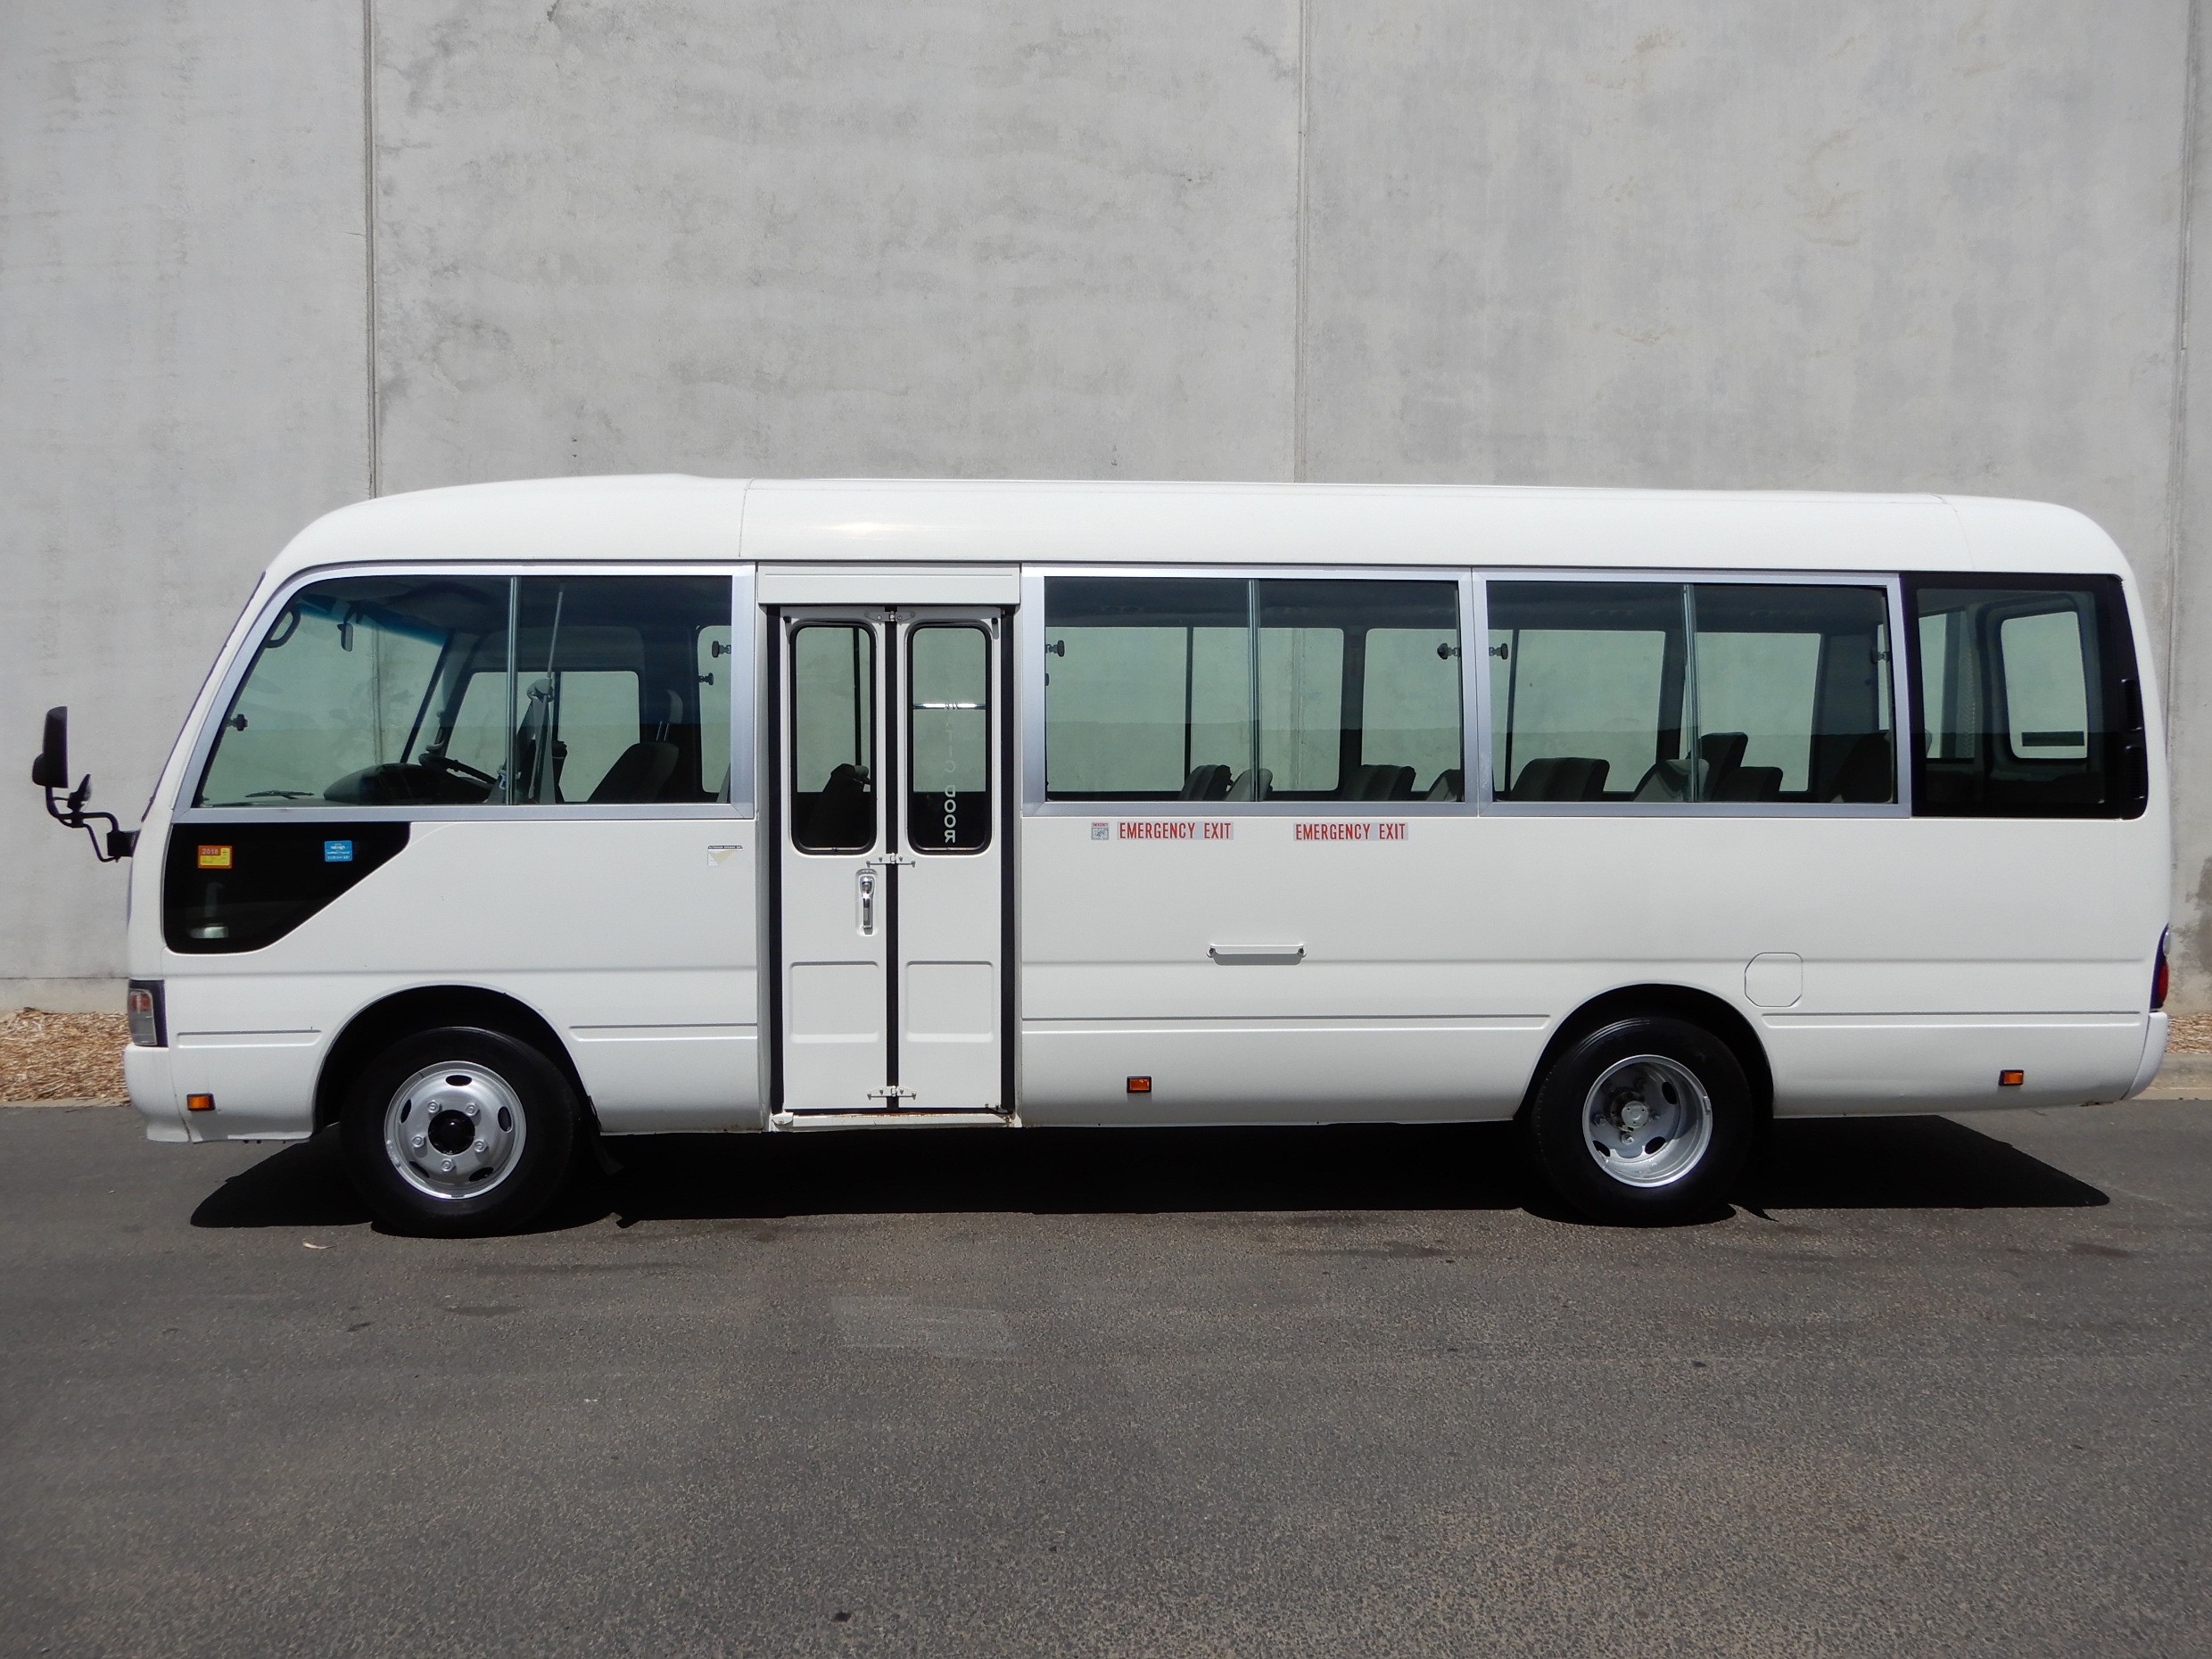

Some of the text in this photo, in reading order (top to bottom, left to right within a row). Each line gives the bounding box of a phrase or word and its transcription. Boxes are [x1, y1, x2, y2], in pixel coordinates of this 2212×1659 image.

[1119, 822, 1232, 839] EMERGENCY EXIT
[1295, 823, 1406, 840] EMERGENCY EXIT
